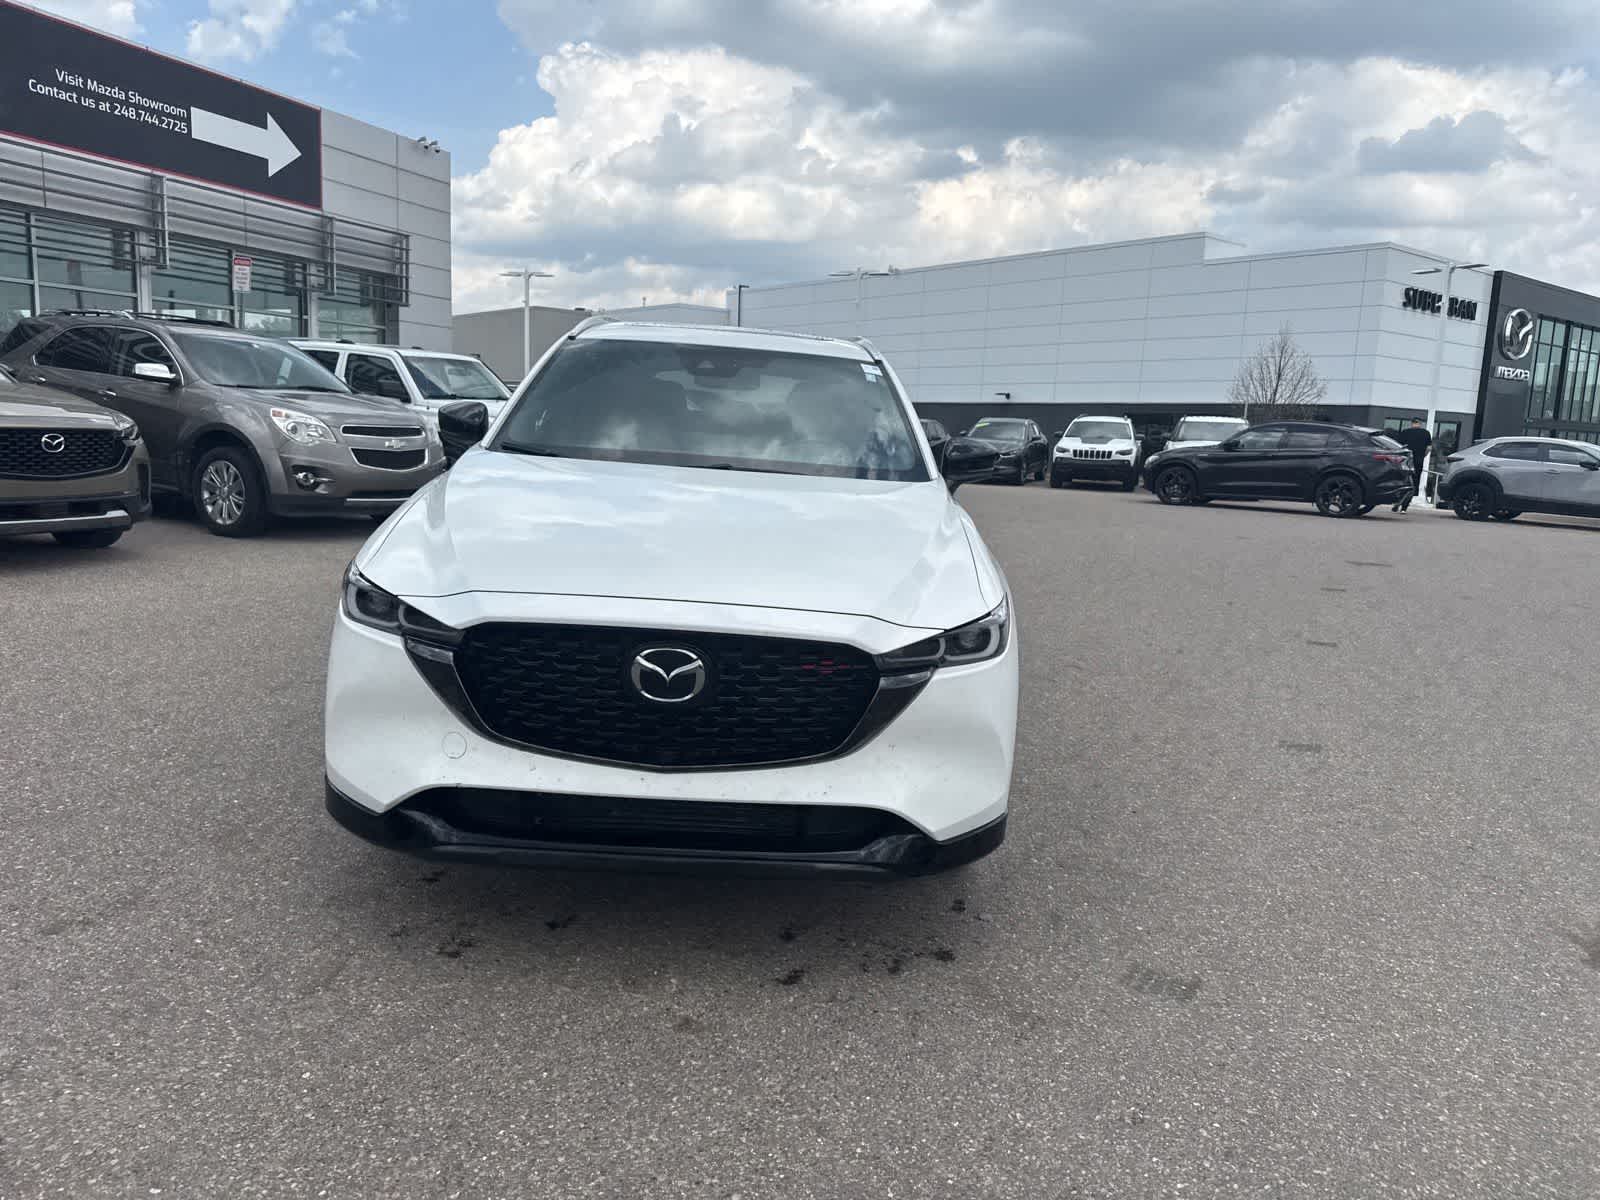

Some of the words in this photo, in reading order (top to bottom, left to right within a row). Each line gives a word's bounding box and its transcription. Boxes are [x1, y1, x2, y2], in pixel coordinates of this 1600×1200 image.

[28, 78, 79, 104] Contact
[81, 95, 96, 109] us
[98, 101, 111, 113] at
[113, 102, 188, 134] 248.744.2725
[55, 68, 84, 89] Visit
[86, 78, 126, 101] Mazda
[128, 90, 187, 119] Showroom
